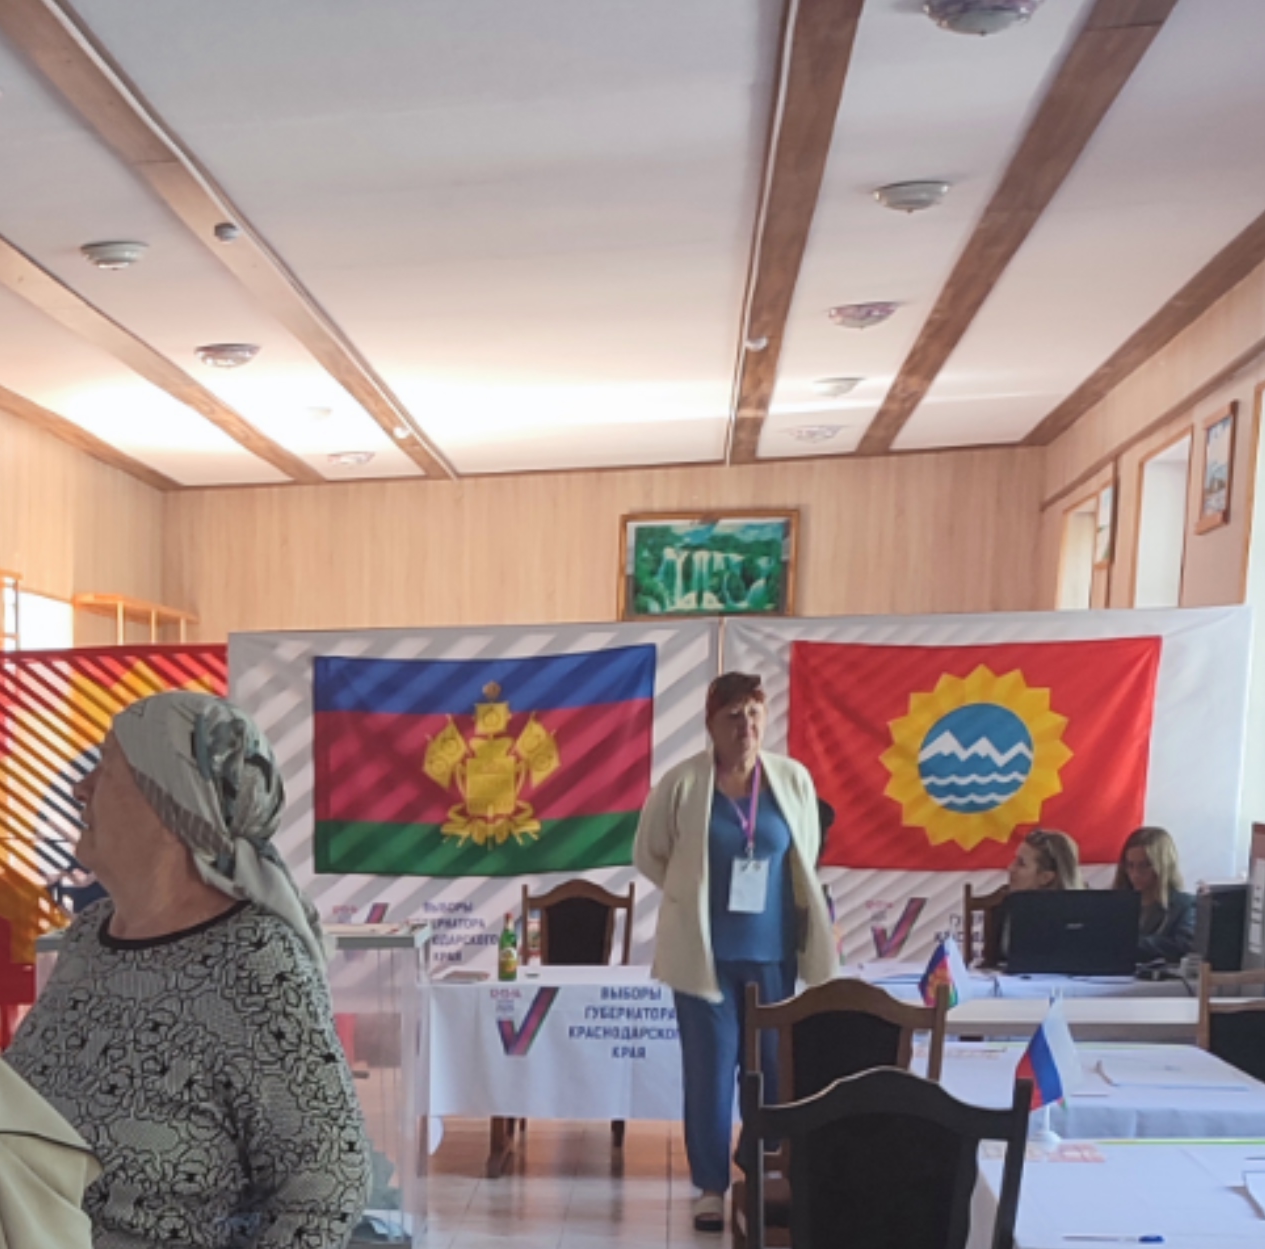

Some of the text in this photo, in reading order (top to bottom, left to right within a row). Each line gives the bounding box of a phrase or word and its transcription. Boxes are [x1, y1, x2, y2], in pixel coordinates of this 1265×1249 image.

[600, 987, 662, 1000] ВЫБОРЫ
[585, 1006, 677, 1020] ГУБЕРНАТОРА
[569, 1026, 680, 1040] КРАСНОДАРСКО
[612, 1047, 647, 1059] КРАЯ
